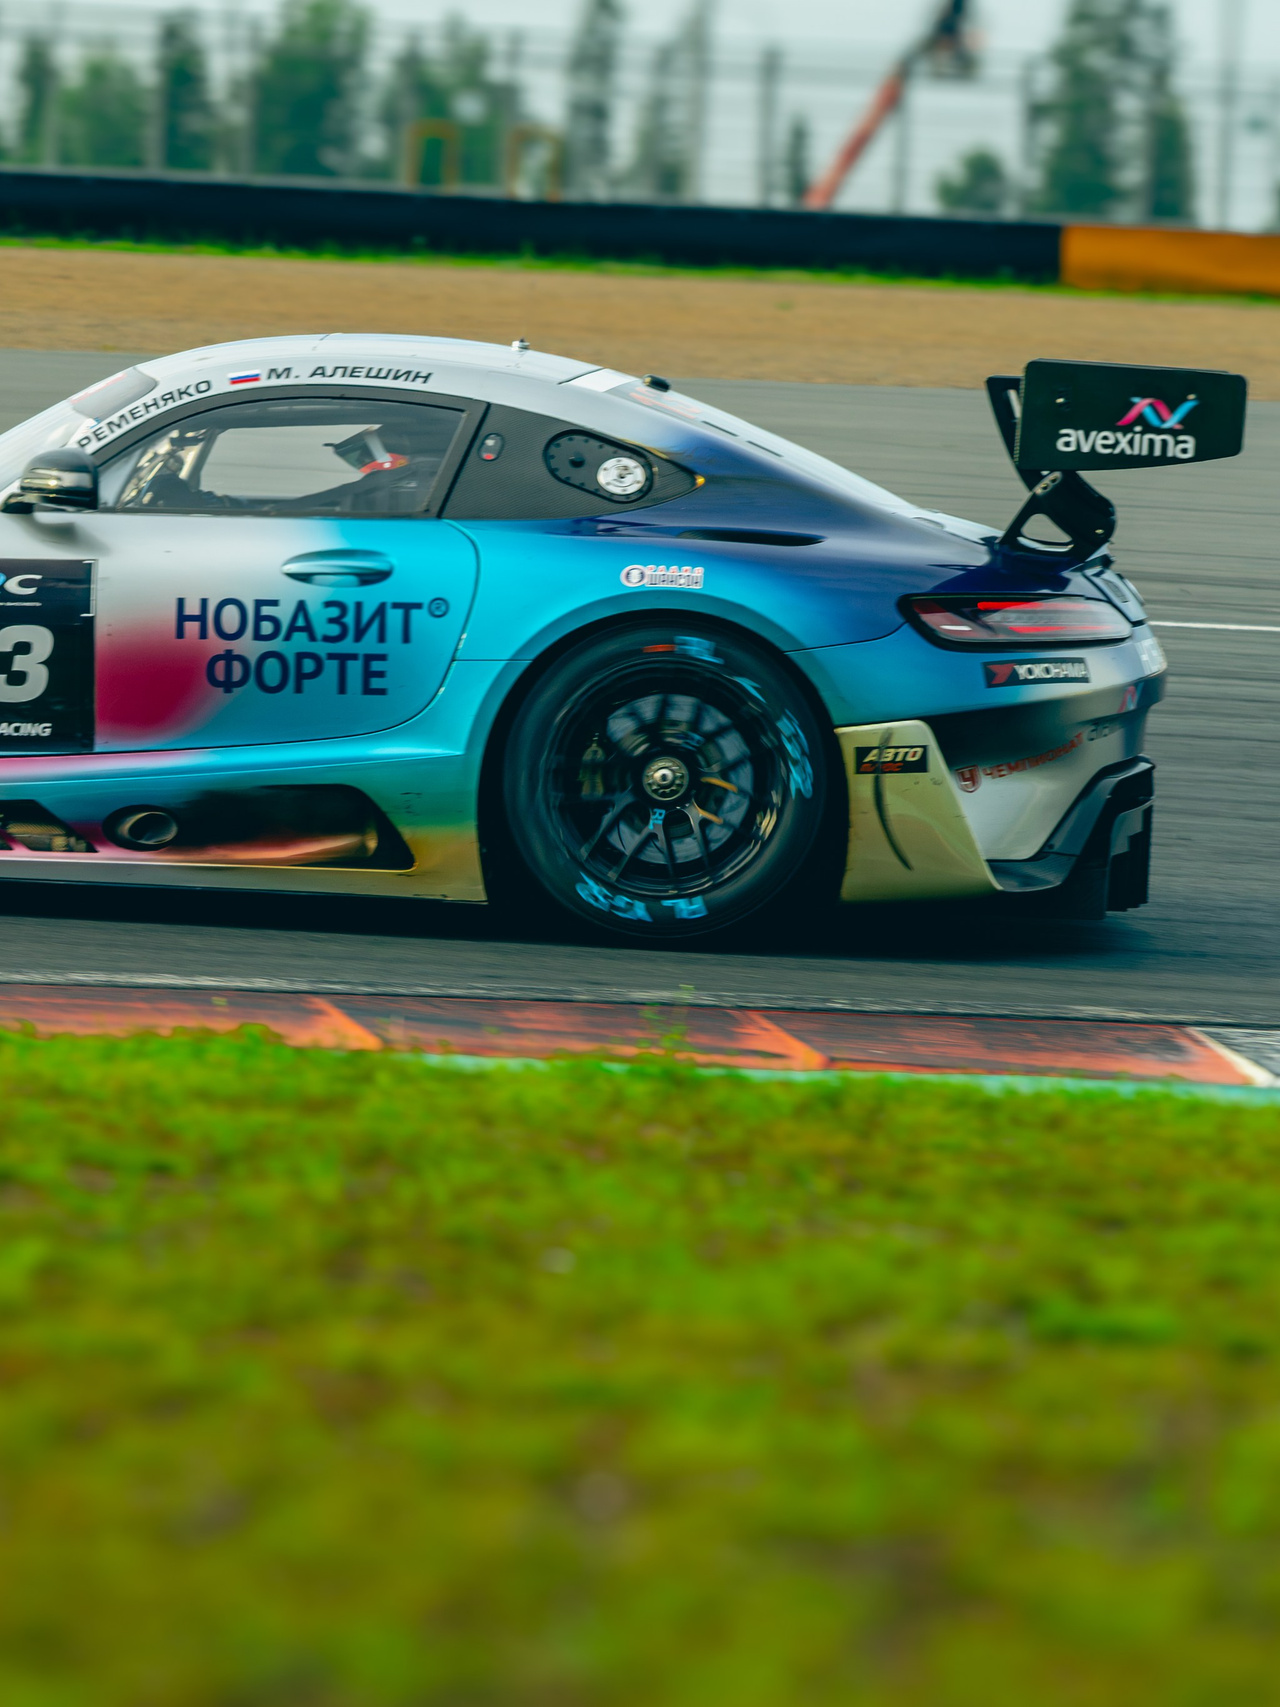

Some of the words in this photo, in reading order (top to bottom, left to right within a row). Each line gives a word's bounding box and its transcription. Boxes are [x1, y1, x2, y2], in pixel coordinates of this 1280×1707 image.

[267, 367, 300, 380] М.
[308, 366, 434, 384] АЛЕШИН
[1055, 425, 1197, 460] avexima
[206, 649, 388, 696] ФОРТЕ
[1014, 662, 1088, 680] YOKOHAMA
[862, 747, 924, 763] АВТО
